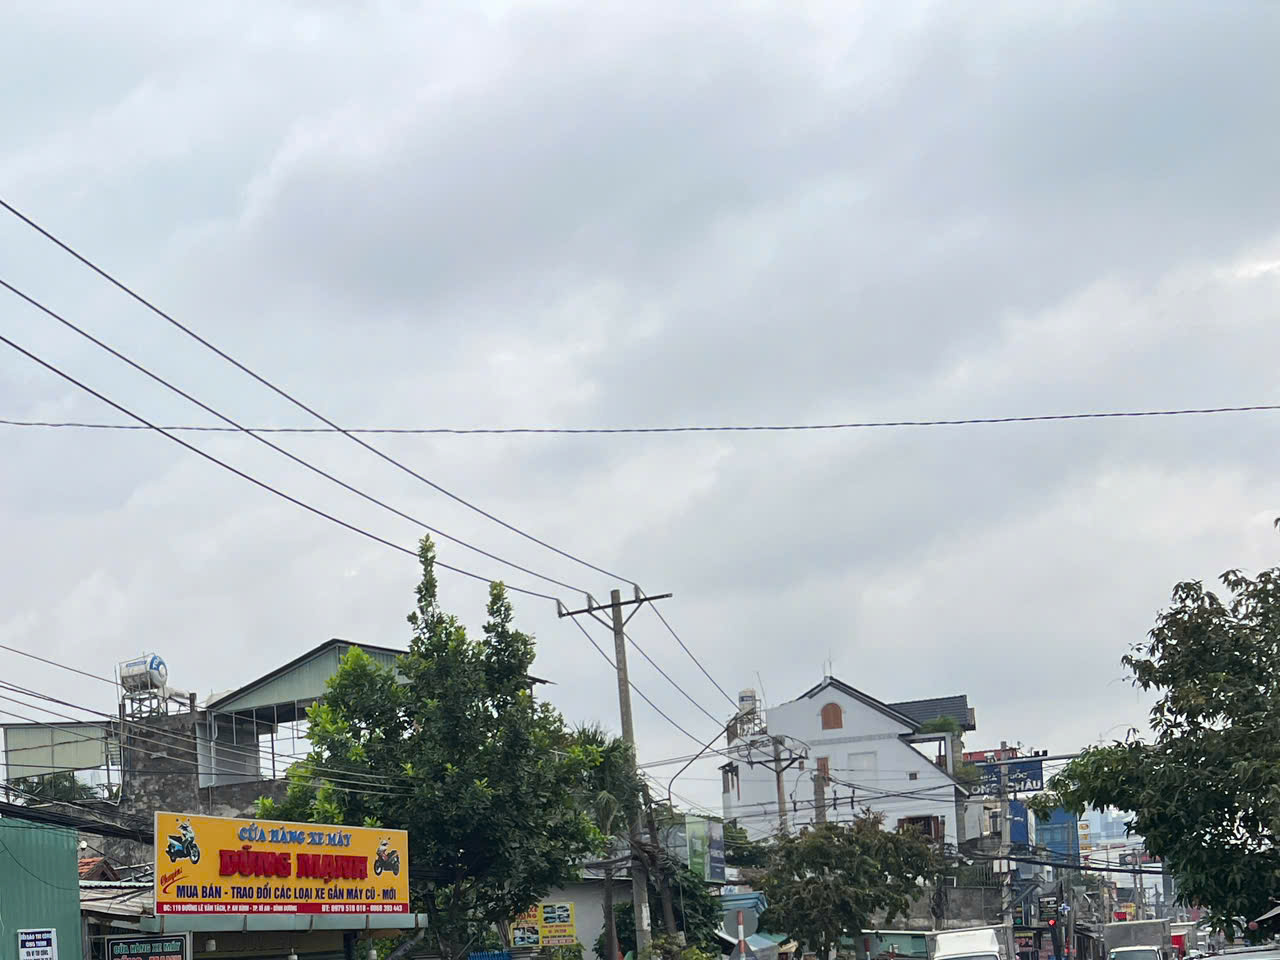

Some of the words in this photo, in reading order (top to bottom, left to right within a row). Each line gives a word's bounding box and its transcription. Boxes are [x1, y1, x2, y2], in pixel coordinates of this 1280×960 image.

[971, 783, 998, 794] ONG
[239, 822, 267, 843] CỬA
[269, 826, 306, 845] HÀNG
[307, 831, 324, 845] XE
[325, 830, 353, 847] MÁY
[219, 845, 292, 878] DŨNG
[296, 853, 369, 884] MẠNH
[176, 885, 199, 899] MUA
[201, 882, 222, 899] BÁN
[231, 886, 254, 899] TRAO
[274, 882, 291, 900] CÁC
[294, 887, 313, 902] LOẠI
[315, 887, 325, 900] XE
[346, 885, 363, 900] MÁY
[365, 886, 376, 900] CŨ
[382, 886, 397, 900] MỚI
[114, 943, 129, 954] CỬA
[130, 943, 150, 954] HÀNG
[152, 943, 162, 952] XE
